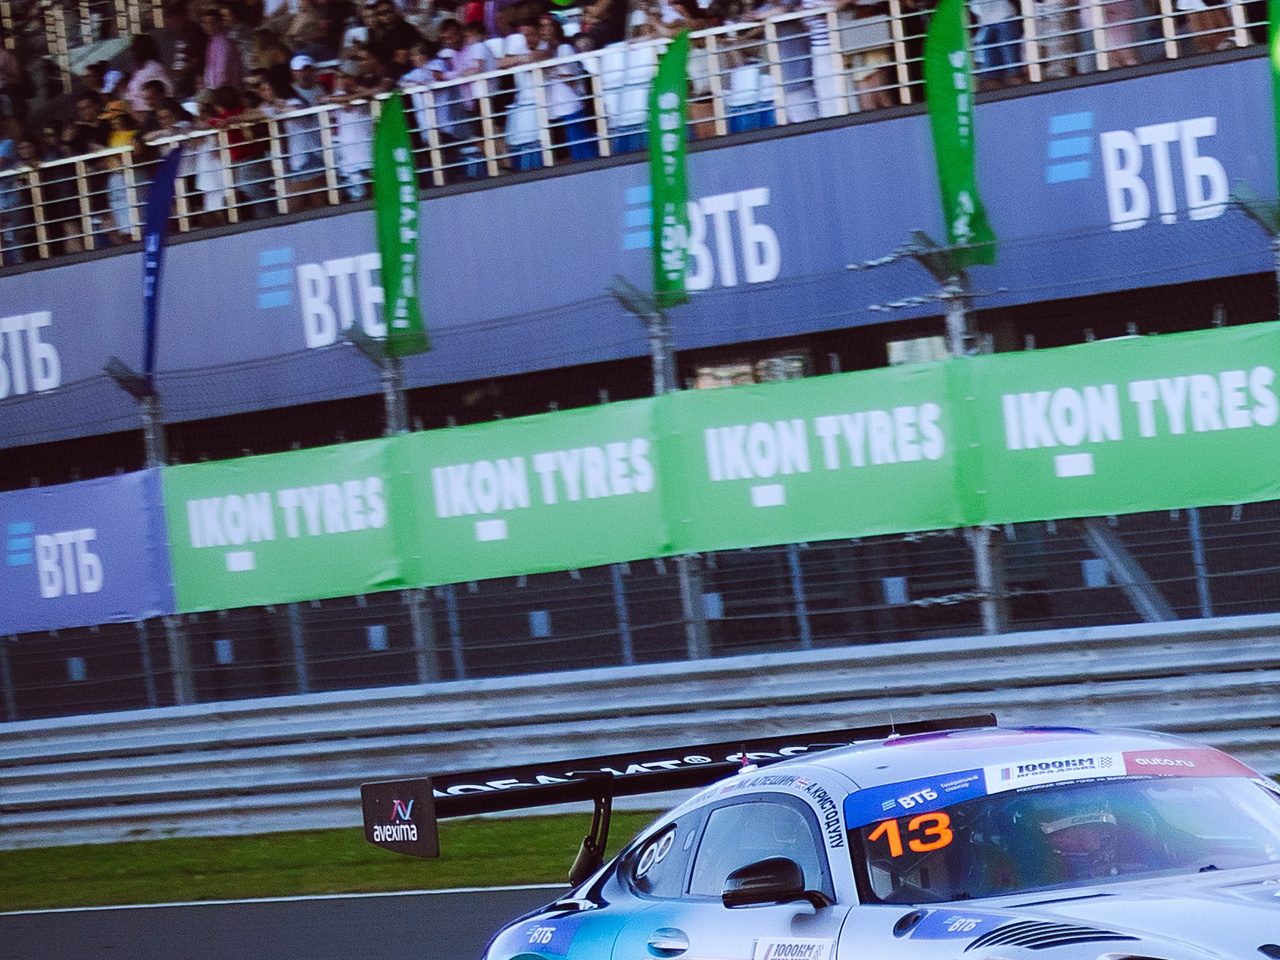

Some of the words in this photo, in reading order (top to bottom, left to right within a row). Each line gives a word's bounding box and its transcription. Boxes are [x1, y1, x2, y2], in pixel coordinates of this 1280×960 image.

[1100, 117, 1229, 231] ВТБ
[0, 311, 61, 400] ТБ
[705, 419, 811, 482] IKON
[814, 403, 945, 470] TYRES
[1003, 384, 1122, 450] IKON
[1129, 366, 1280, 438] TYRES
[187, 492, 275, 548] IKON
[277, 476, 388, 538] TYRES
[432, 457, 531, 518] IKON
[533, 438, 654, 505] TYRES
[35, 528, 102, 599] ВТБ
[1134, 755, 1196, 769] auto.ru
[373, 820, 418, 842] avexima
[898, 787, 938, 809] ВТБ
[868, 811, 954, 858] 13
[529, 927, 557, 944] ВТБ
[947, 918, 983, 932] ВТБ
